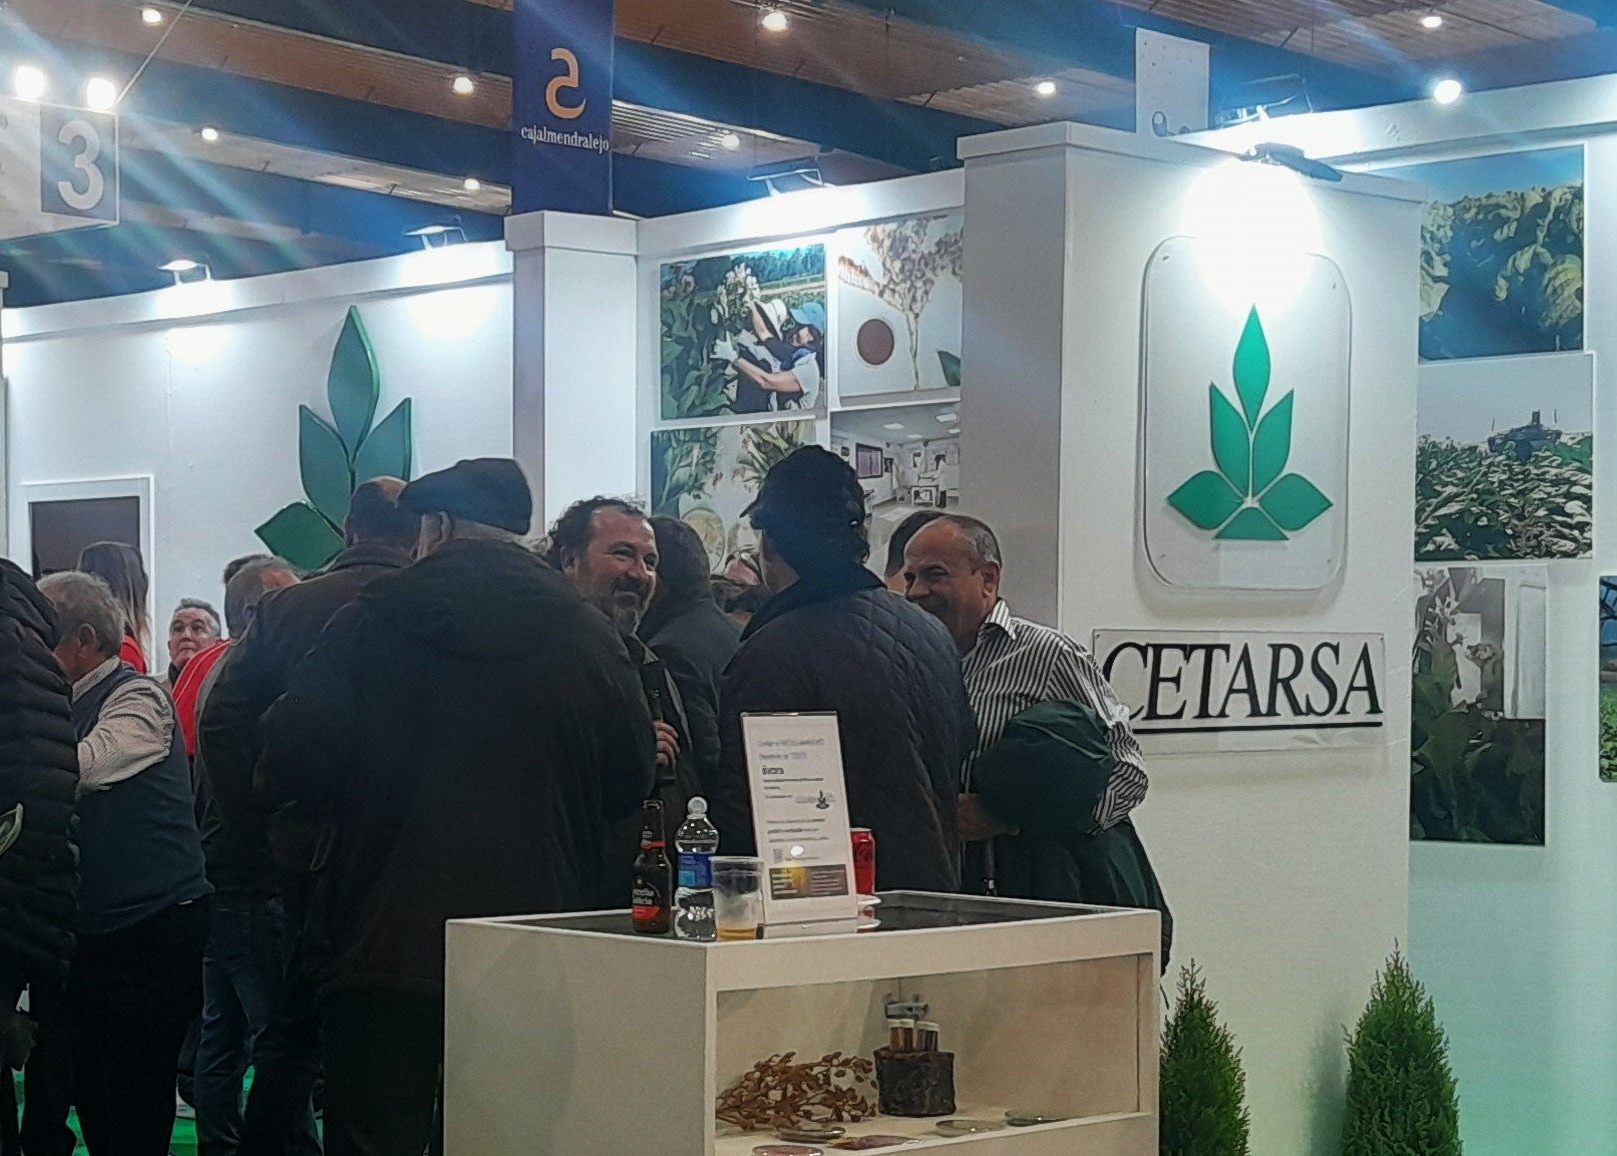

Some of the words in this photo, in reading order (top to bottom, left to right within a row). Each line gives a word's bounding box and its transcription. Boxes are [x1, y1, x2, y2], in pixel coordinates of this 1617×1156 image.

[57, 119, 105, 211] 3
[520, 125, 611, 155] cajalmendralejo
[1102, 641, 1384, 721] CETARSA
